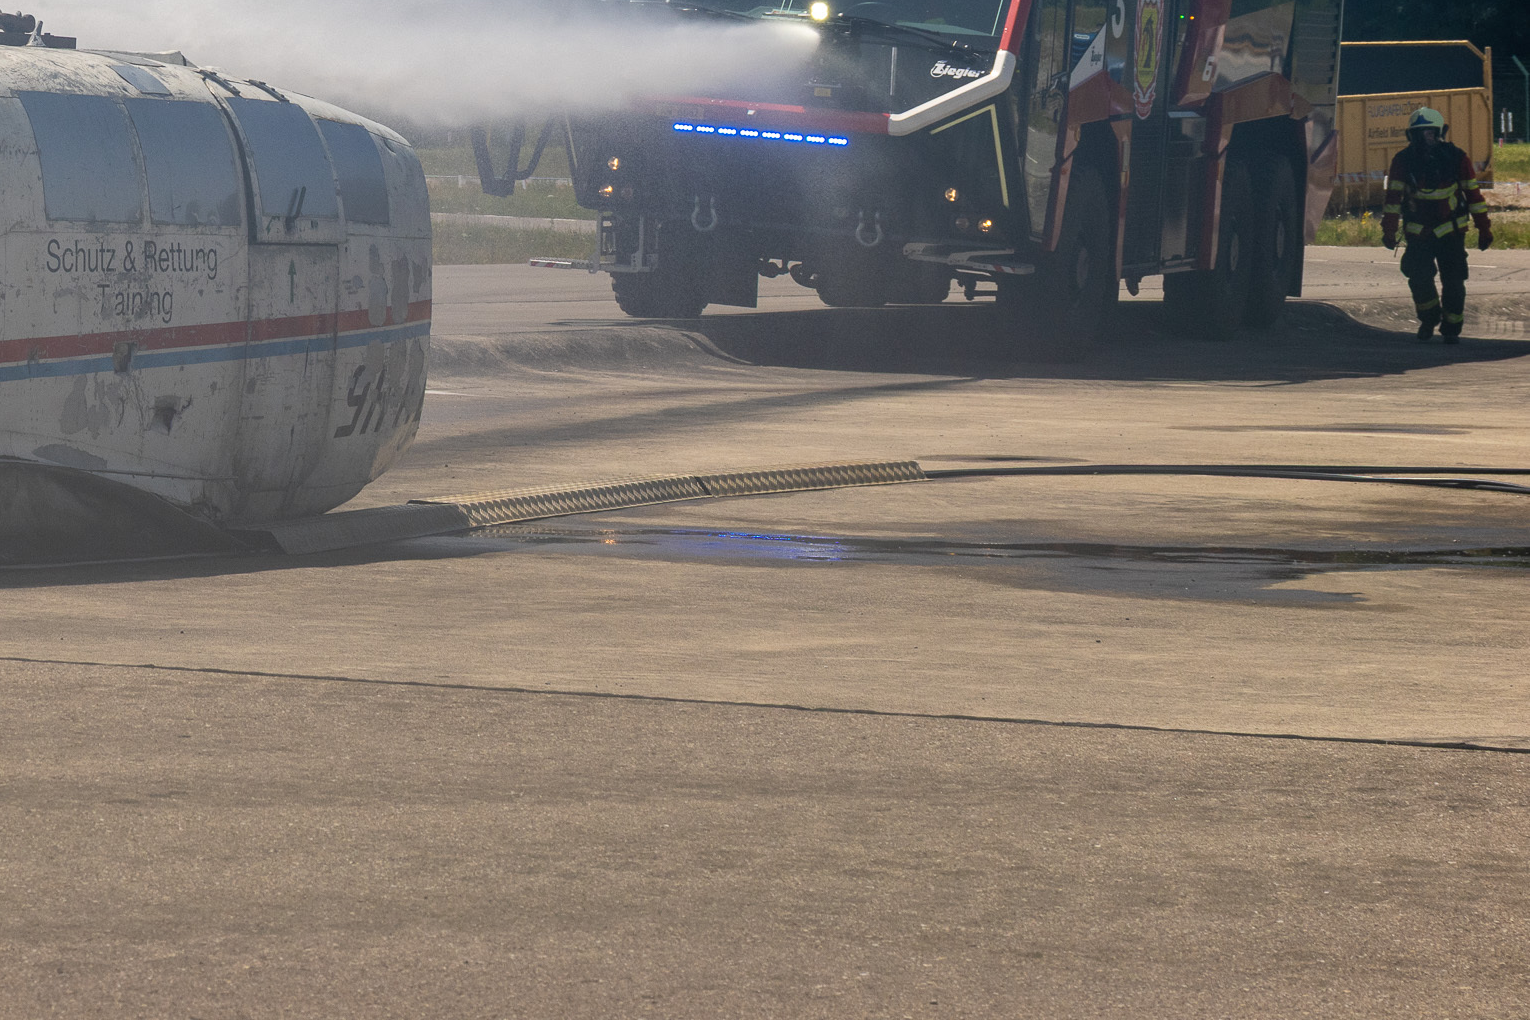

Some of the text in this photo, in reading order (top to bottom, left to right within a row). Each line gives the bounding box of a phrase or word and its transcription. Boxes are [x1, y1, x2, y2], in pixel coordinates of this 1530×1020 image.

[930, 60, 985, 79] Ziegler
[46, 238, 218, 280] Schutz & Rettung
[96, 283, 174, 324] Taining
